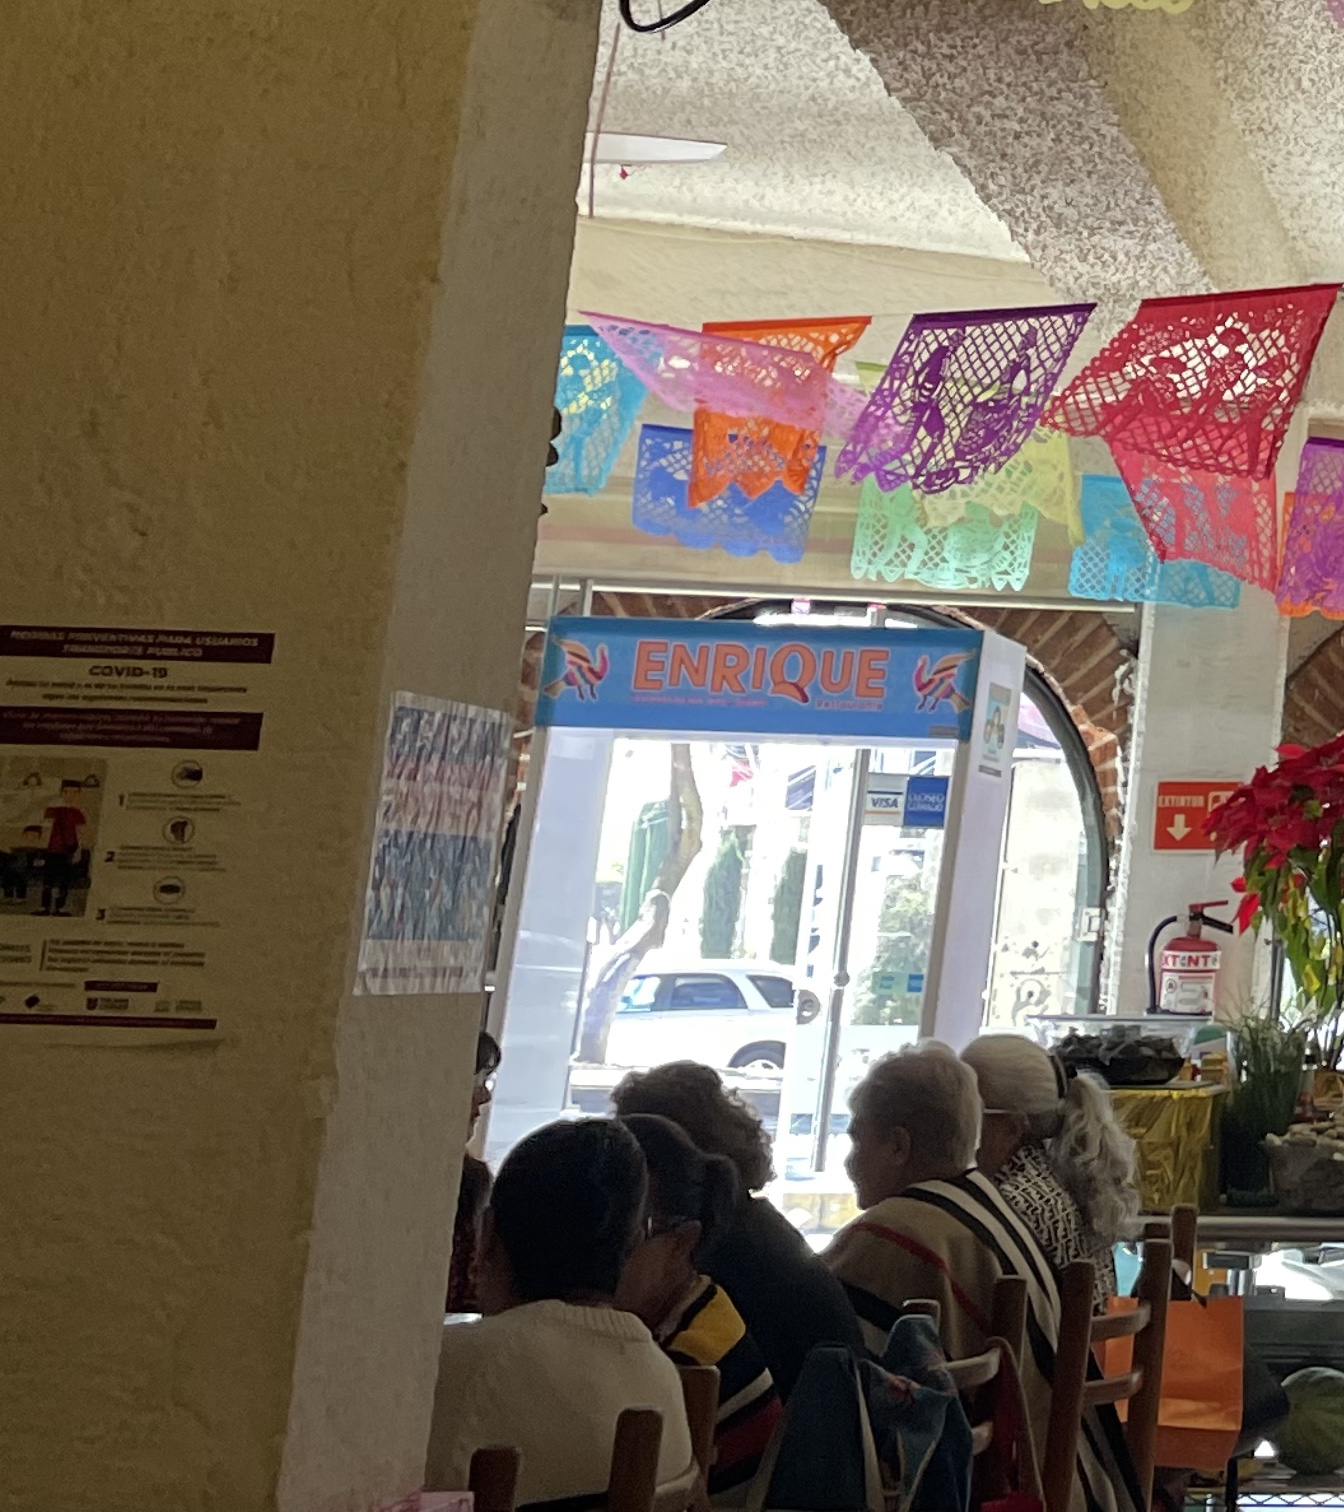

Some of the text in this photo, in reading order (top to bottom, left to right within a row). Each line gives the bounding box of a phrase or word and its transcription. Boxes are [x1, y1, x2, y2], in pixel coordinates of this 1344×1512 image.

[88, 665, 168, 679] COVID-19
[633, 640, 890, 703] ENRIQUE
[871, 797, 899, 808] VISA
[1158, 795, 1204, 807] EXTINTOR
[104, 850, 116, 863] 2
[95, 908, 106, 921] 3
